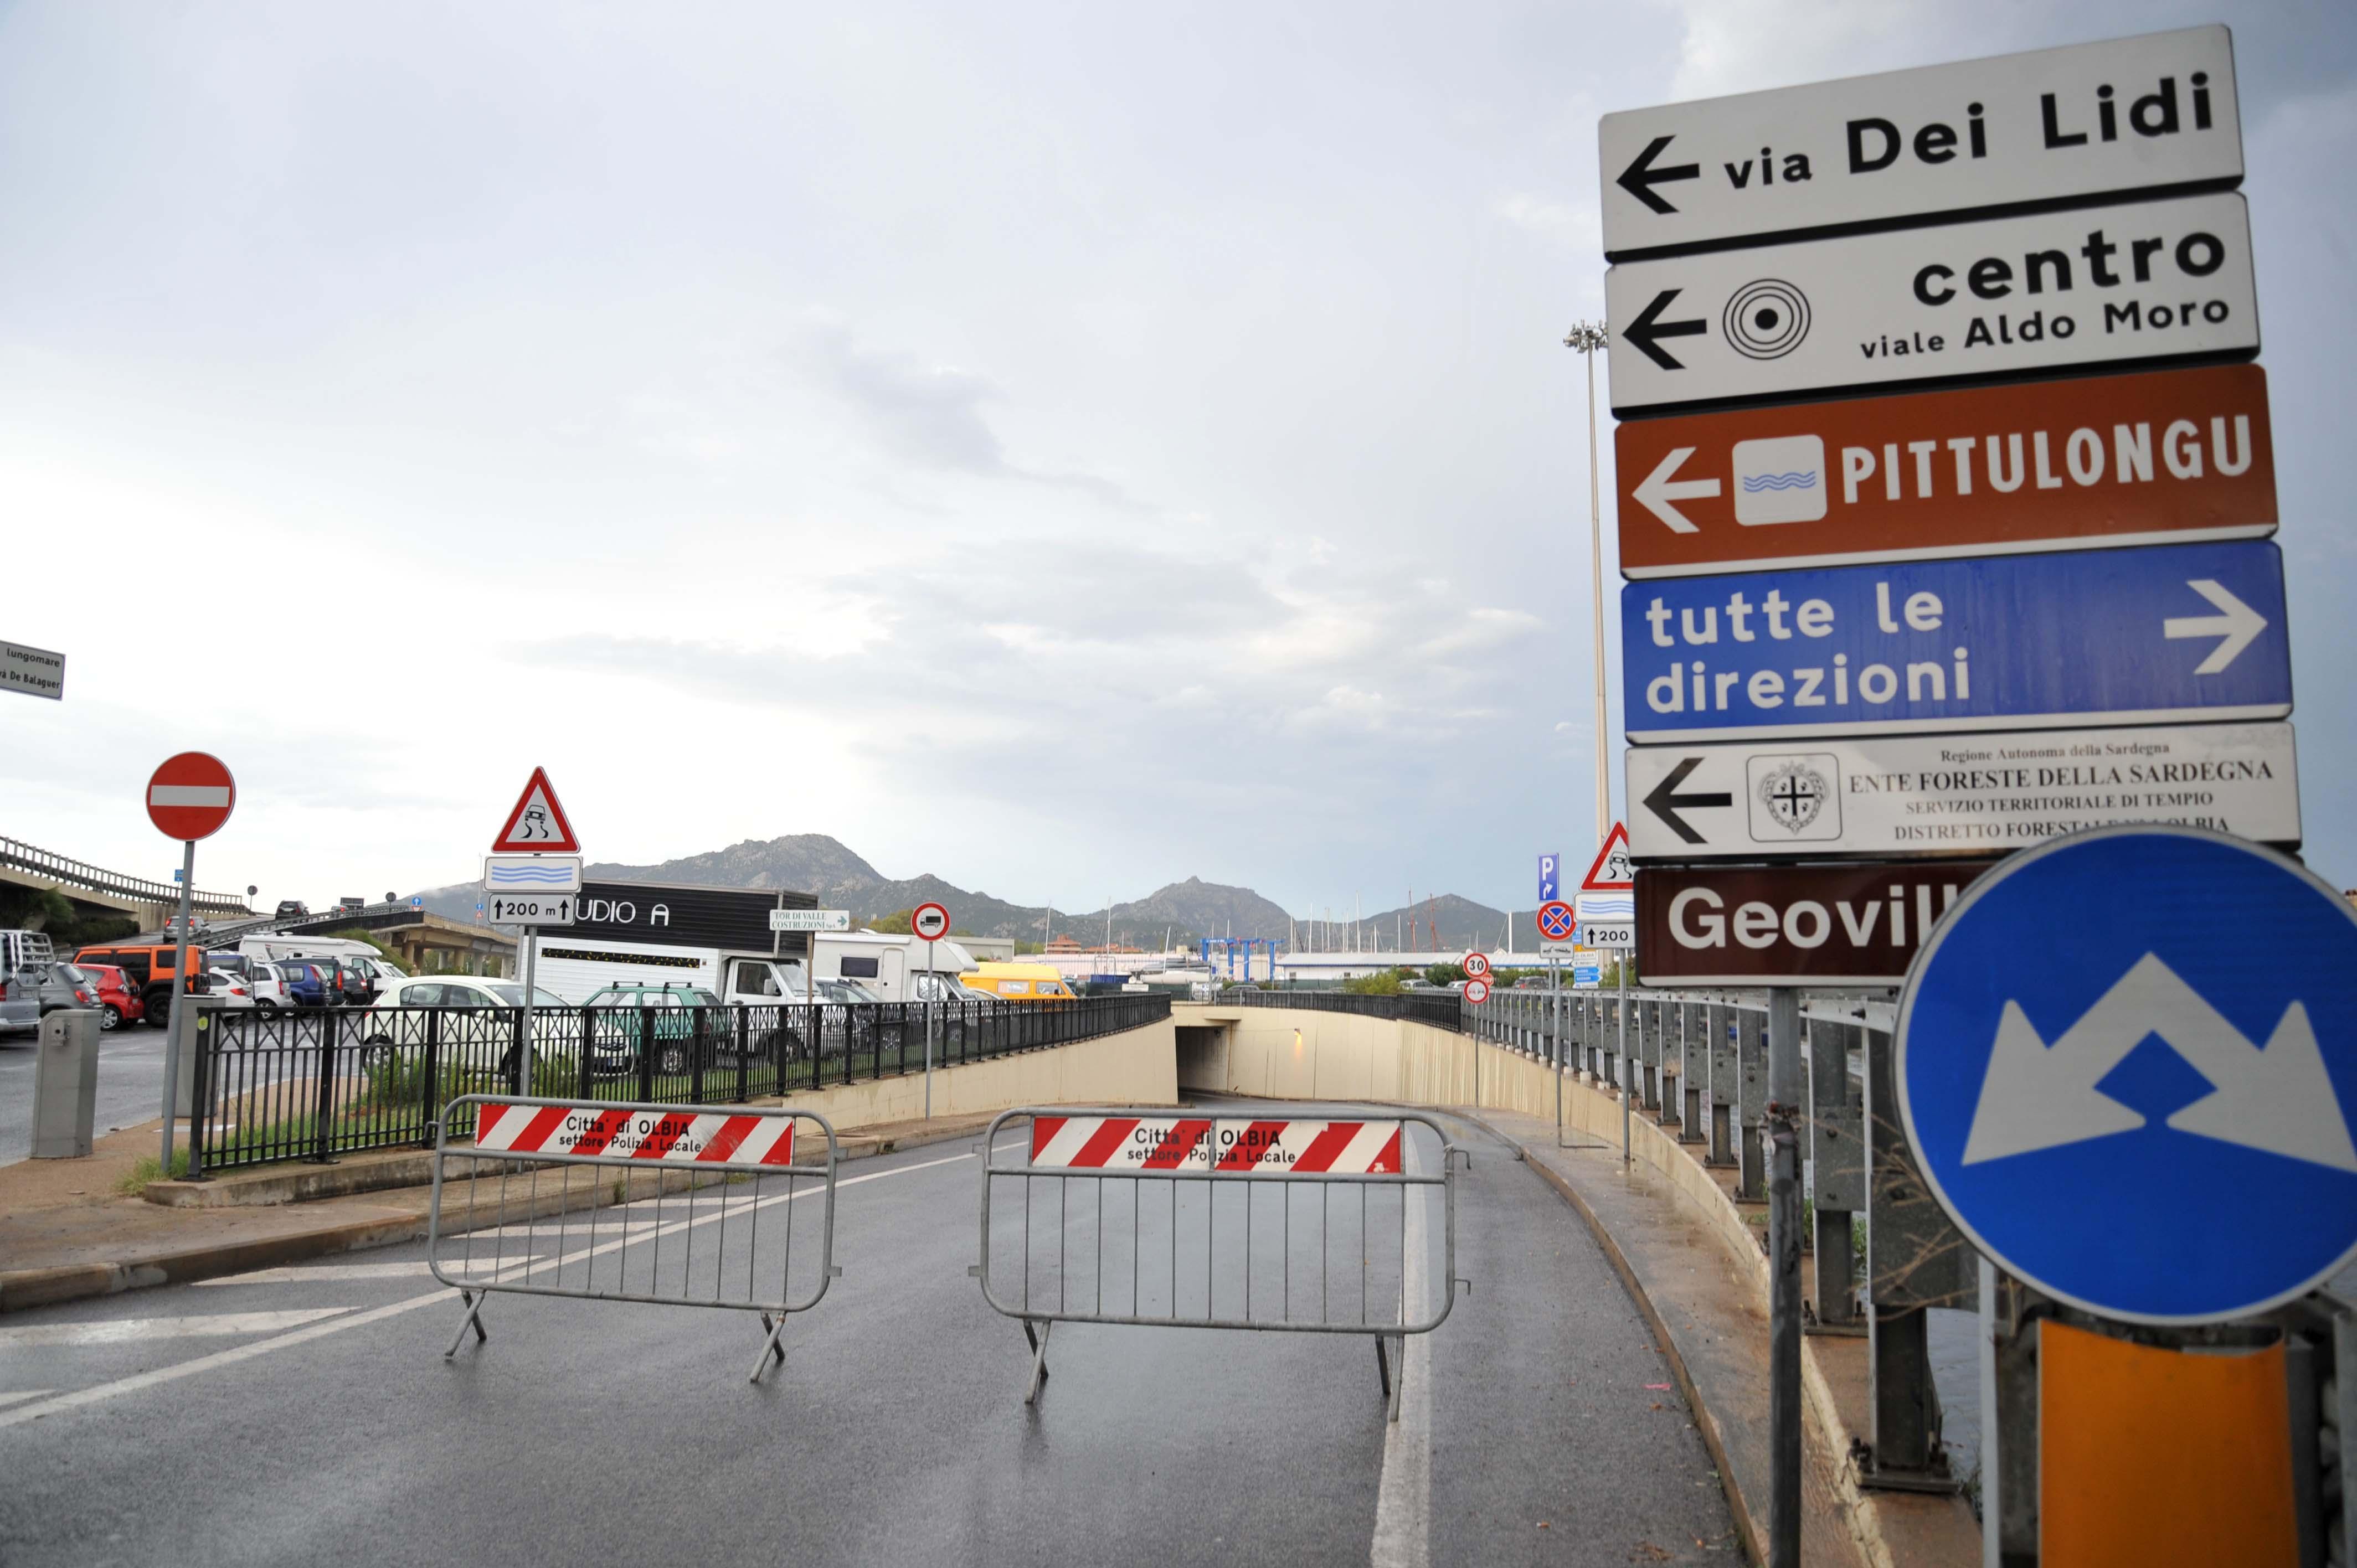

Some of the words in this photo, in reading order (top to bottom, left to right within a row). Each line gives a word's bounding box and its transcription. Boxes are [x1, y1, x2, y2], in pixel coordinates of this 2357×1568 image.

[1725, 147, 1812, 189] via
[1847, 102, 1987, 173] Dei
[2041, 71, 2214, 148] Lidi
[1913, 230, 2226, 306] centro
[1861, 331, 1944, 359] viale
[1964, 311, 2076, 349] Aldo
[2104, 299, 2229, 334] Moro
[1842, 415, 2251, 504] PITTULONGU
[1646, 589, 1834, 647] tutte
[1876, 582, 1943, 633] le
[7, 647, 60, 667] lungomare
[10, 670, 20, 681] De
[23, 673, 60, 689] Balaguer
[1646, 648, 1969, 713] direzioni
[1941, 750, 1993, 764] Regione
[1998, 745, 2065, 761] Autonoma
[2070, 744, 2102, 757] della
[2106, 742, 2170, 757] Sardegna
[1850, 773, 1913, 793] ENTE
[1919, 769, 2031, 791] FORESTE
[2038, 766, 2122, 787] DELLA
[2129, 760, 2275, 784] SARDEGNA
[1906, 800, 1984, 814] SERVIZIO
[1988, 795, 2117, 812] TERRITORIALE
[2121, 794, 2139, 808] DI
[2144, 792, 2214, 807] TEMPIO
[1895, 823, 2001, 840] DISTRETTO
[1542, 857, 1553, 880] P
[506, 902, 538, 916] 200
[545, 907, 555, 916] m
[775, 912, 791, 920] TOR
[792, 912, 800, 920] DI
[802, 912, 826, 920] VALLE
[772, 921, 825, 929] COSTRUZIONI
[1599, 930, 1629, 941] 200
[1470, 960, 1484, 971] 30
[616, 1117, 630, 1133] di
[639, 1120, 690, 1136] OLBIA
[559, 1134, 604, 1148] settore
[611, 1136, 651, 1150] Polizia
[659, 1138, 702, 1152] Locale
[1195, 1128, 1210, 1145] di
[1221, 1129, 1281, 1146] OLBIA
[1128, 1147, 1181, 1161] settore
[1247, 1149, 1296, 1163] Locale
